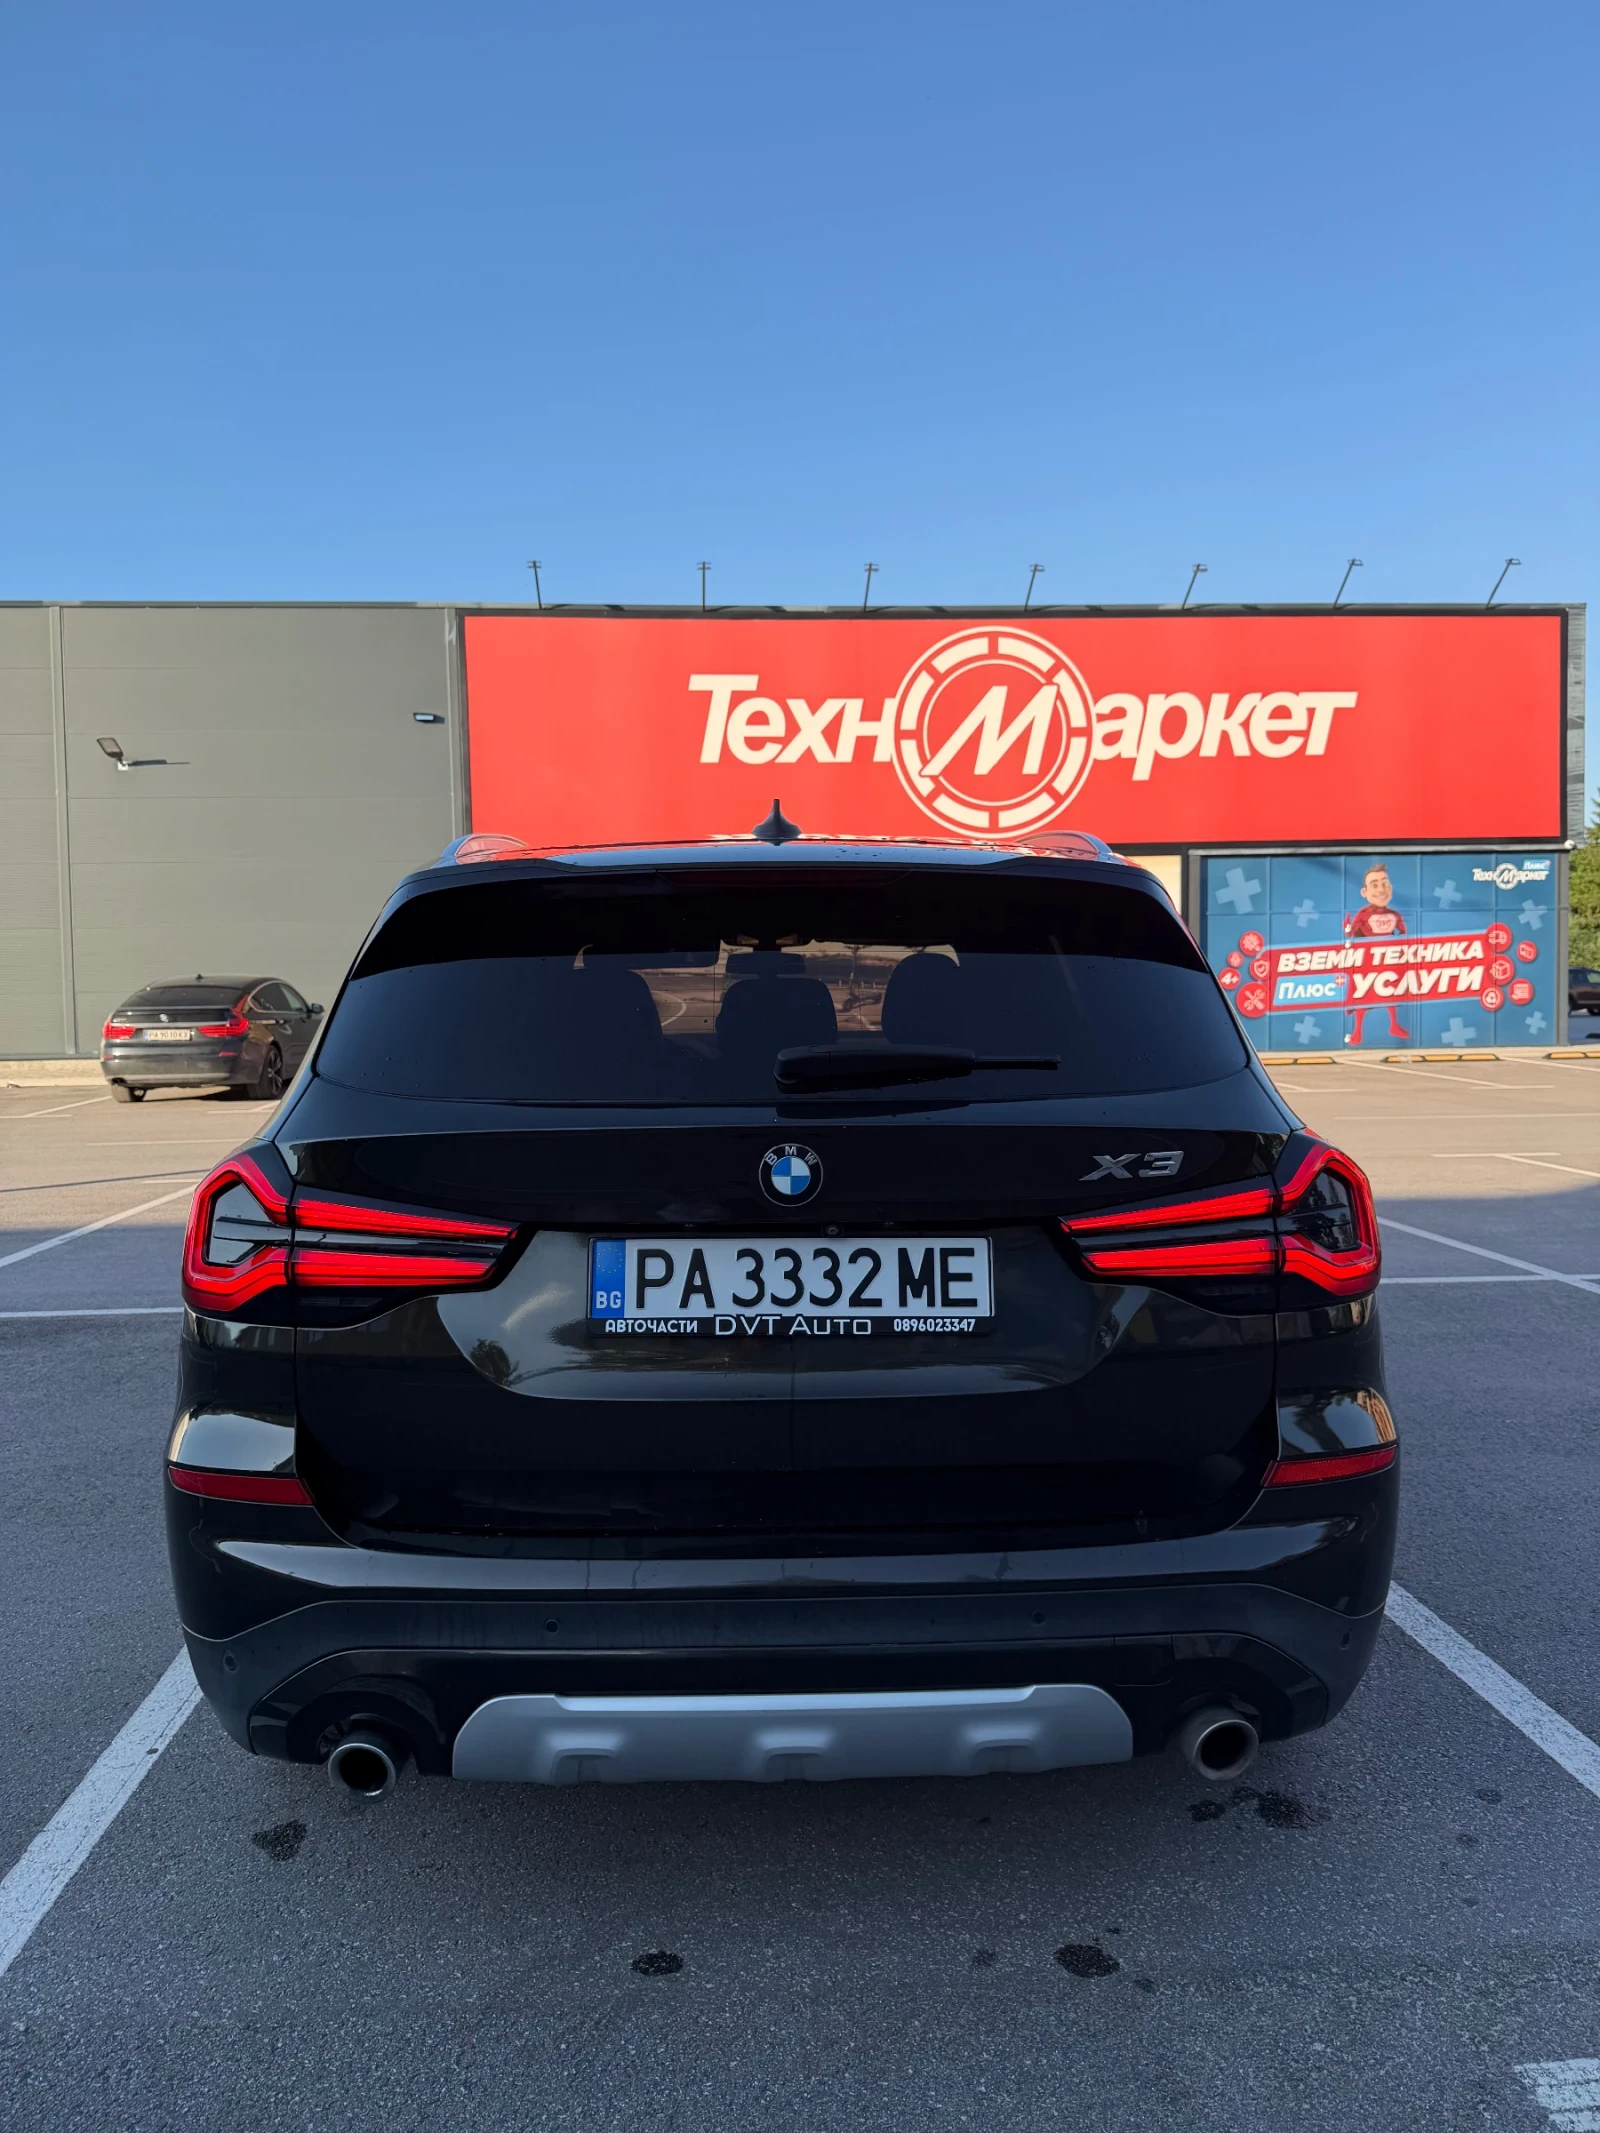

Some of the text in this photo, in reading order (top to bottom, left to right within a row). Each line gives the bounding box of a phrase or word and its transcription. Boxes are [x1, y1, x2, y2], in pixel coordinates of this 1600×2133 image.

[1277, 940, 1484, 972] ВЗЕМИ ТЕХНИКА
[1278, 965, 1485, 999] Плюс УСЛУГИ
[765, 1146, 817, 1166] BMW
[1078, 1151, 1184, 1181] X3
[596, 1291, 622, 1309] BG
[605, 1319, 698, 1333] АВТОЧАСТИ
[715, 1315, 781, 1335] DVT
[893, 1318, 976, 1332] 0896023347
